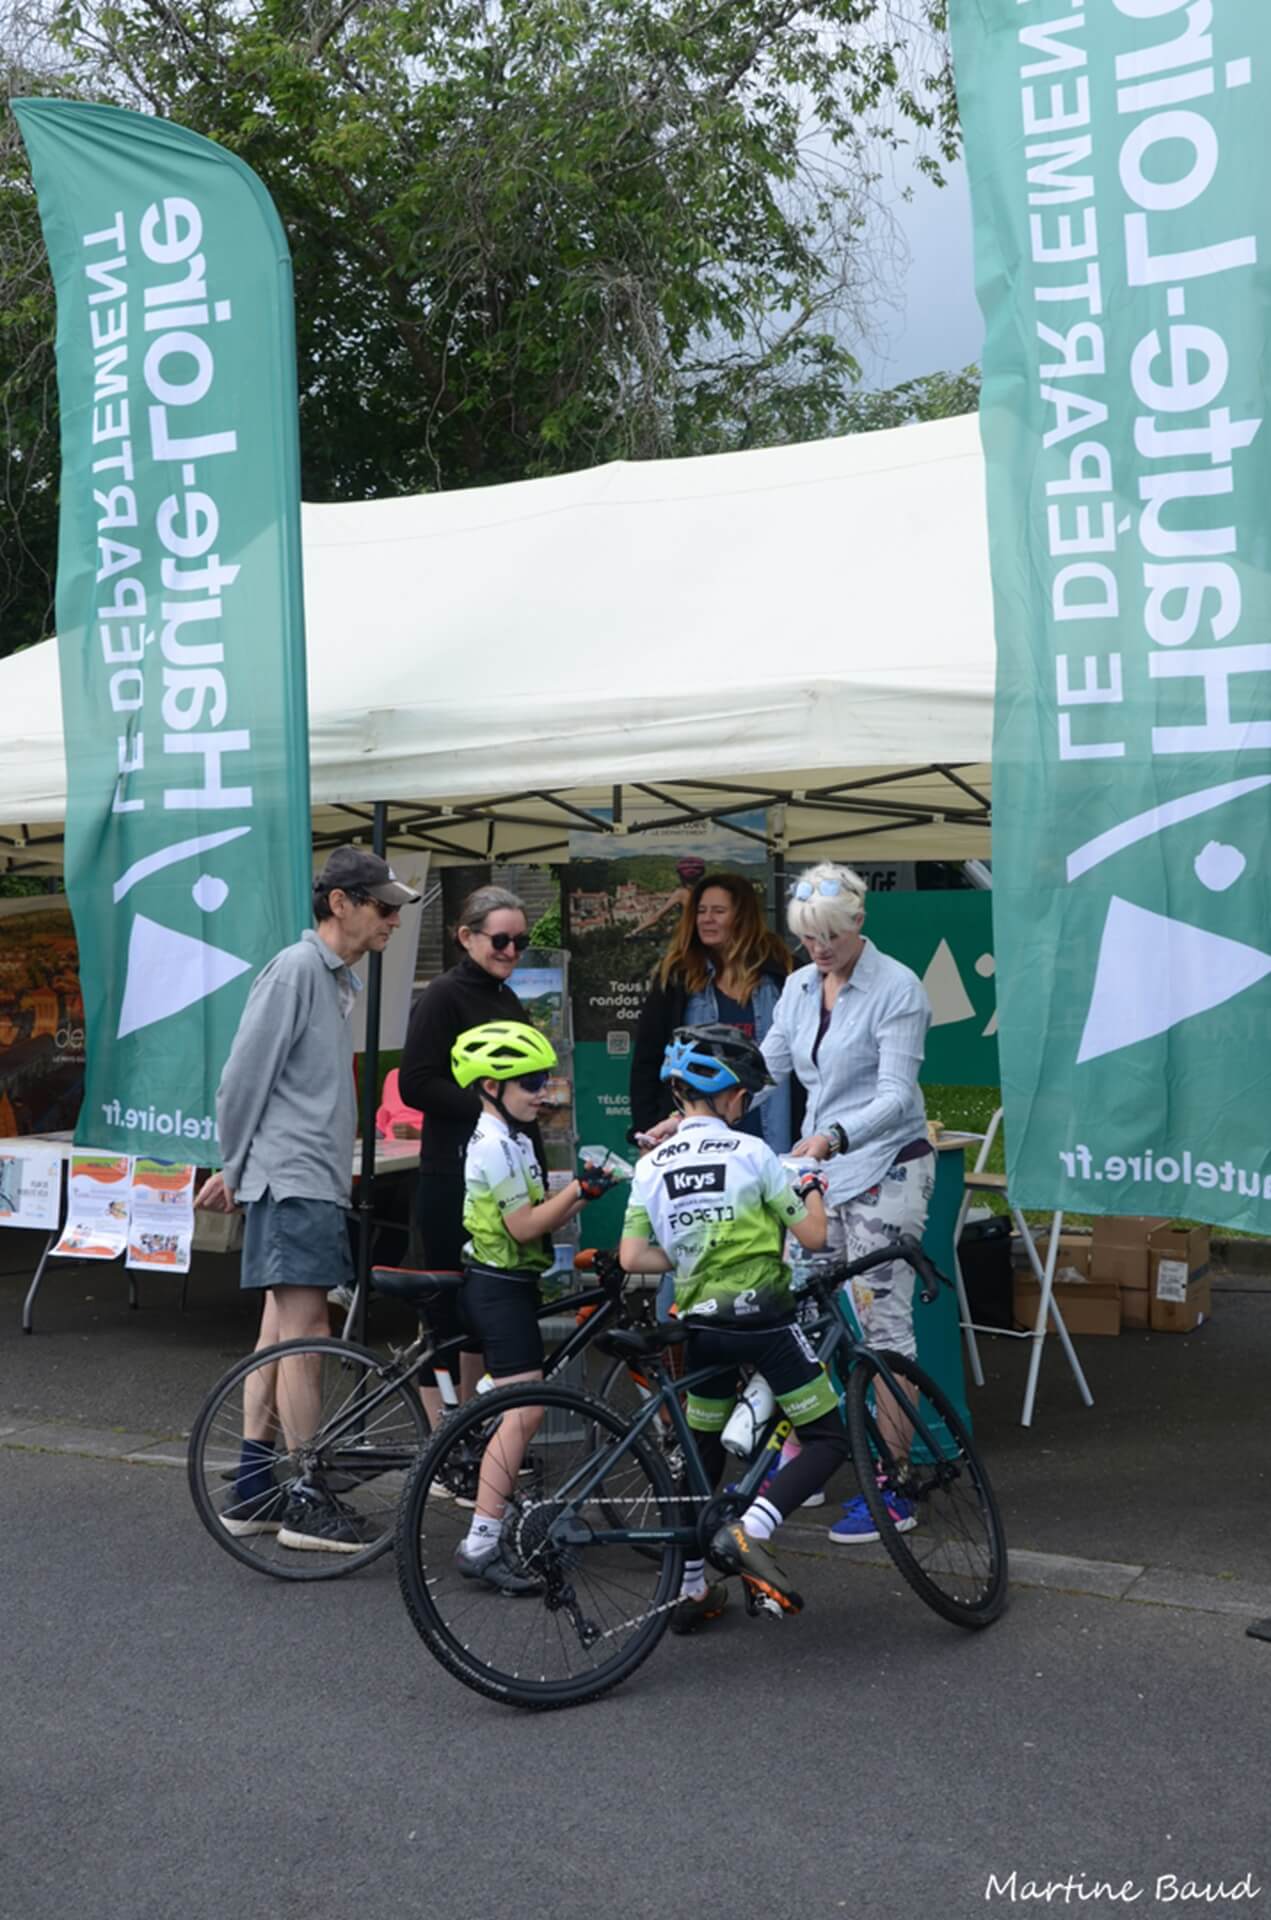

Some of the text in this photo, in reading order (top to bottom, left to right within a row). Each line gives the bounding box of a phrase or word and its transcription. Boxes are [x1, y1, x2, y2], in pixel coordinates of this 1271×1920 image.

[609, 981, 643, 993] Tous
[589, 995, 640, 1006] randos
[656, 1141, 691, 1161] PRO
[673, 1170, 716, 1190] Krys
